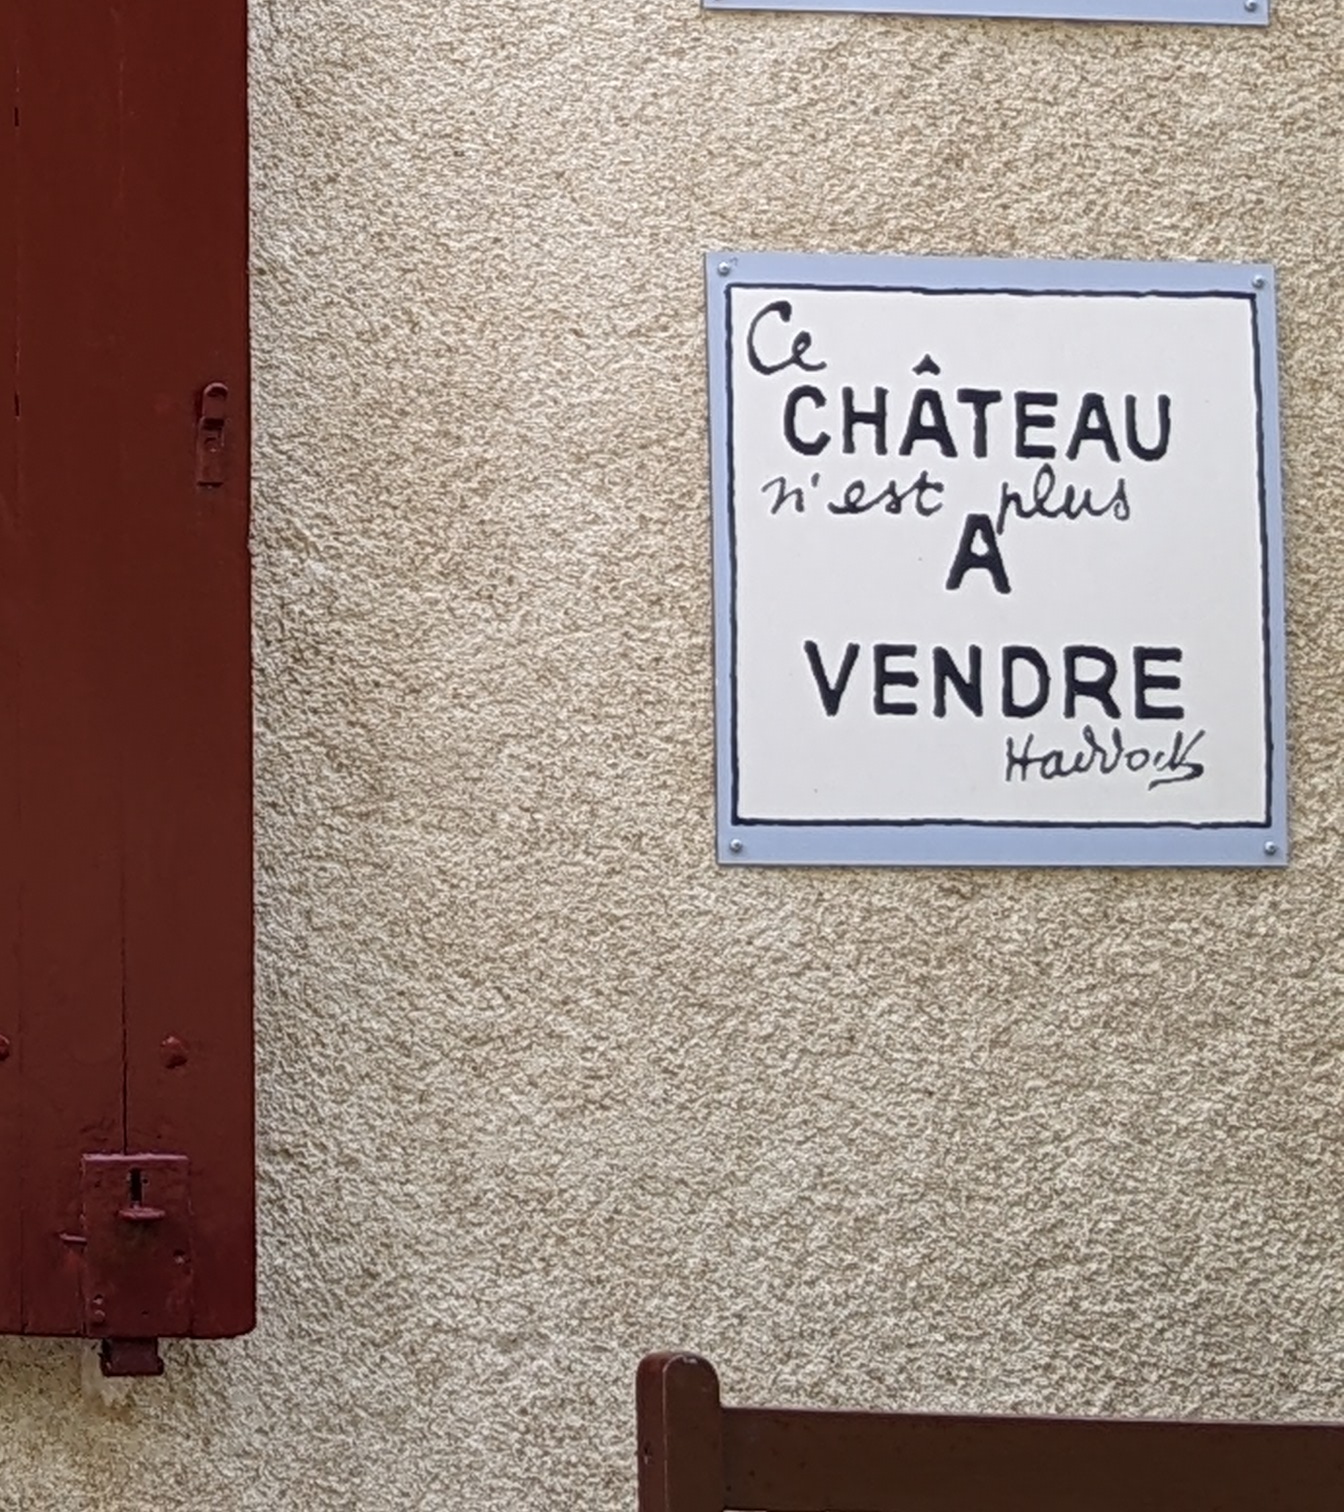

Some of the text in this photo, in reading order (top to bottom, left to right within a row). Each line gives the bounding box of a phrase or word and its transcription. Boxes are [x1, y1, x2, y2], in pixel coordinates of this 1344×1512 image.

[746, 300, 827, 376] Ce
[783, 354, 1171, 463] CHÂTEAU
[762, 462, 1132, 536] n'est plus
[945, 513, 1012, 595] A
[804, 640, 1185, 721] VENDRE
